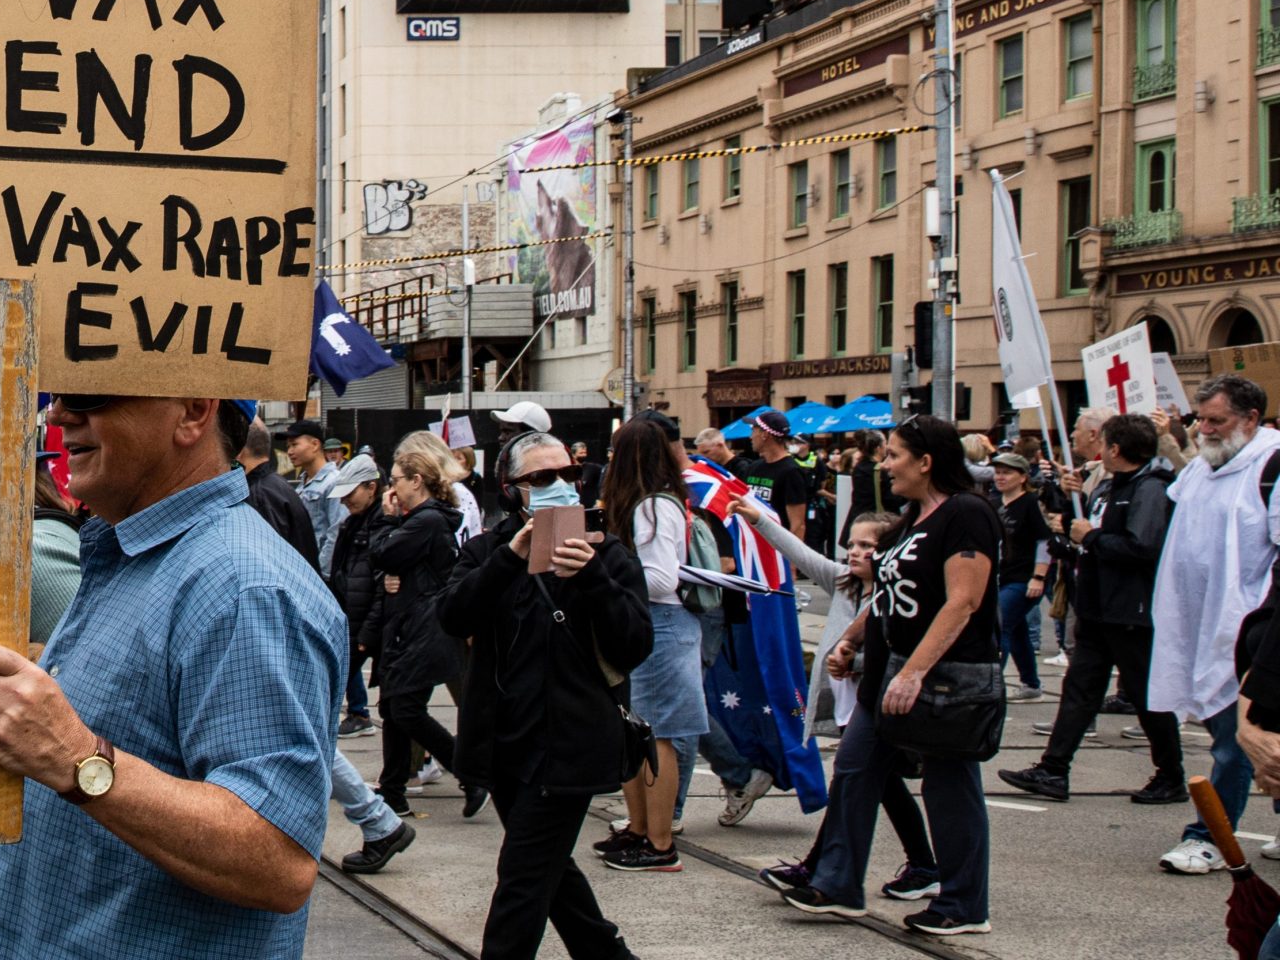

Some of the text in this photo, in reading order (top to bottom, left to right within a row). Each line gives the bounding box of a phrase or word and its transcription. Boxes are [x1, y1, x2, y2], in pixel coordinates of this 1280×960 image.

[927, 13, 974, 42] YNG
[980, 0, 1010, 24] AND
[821, 56, 861, 82] HOTEL
[1, 184, 143, 273] VAX
[160, 194, 316, 285] RAPE
[1140, 265, 1216, 289] YOUNG
[1223, 267, 1234, 280] &
[64, 281, 272, 365] EVIL
[782, 362, 819, 376] YOUNG
[831, 356, 890, 374] JACKSON
